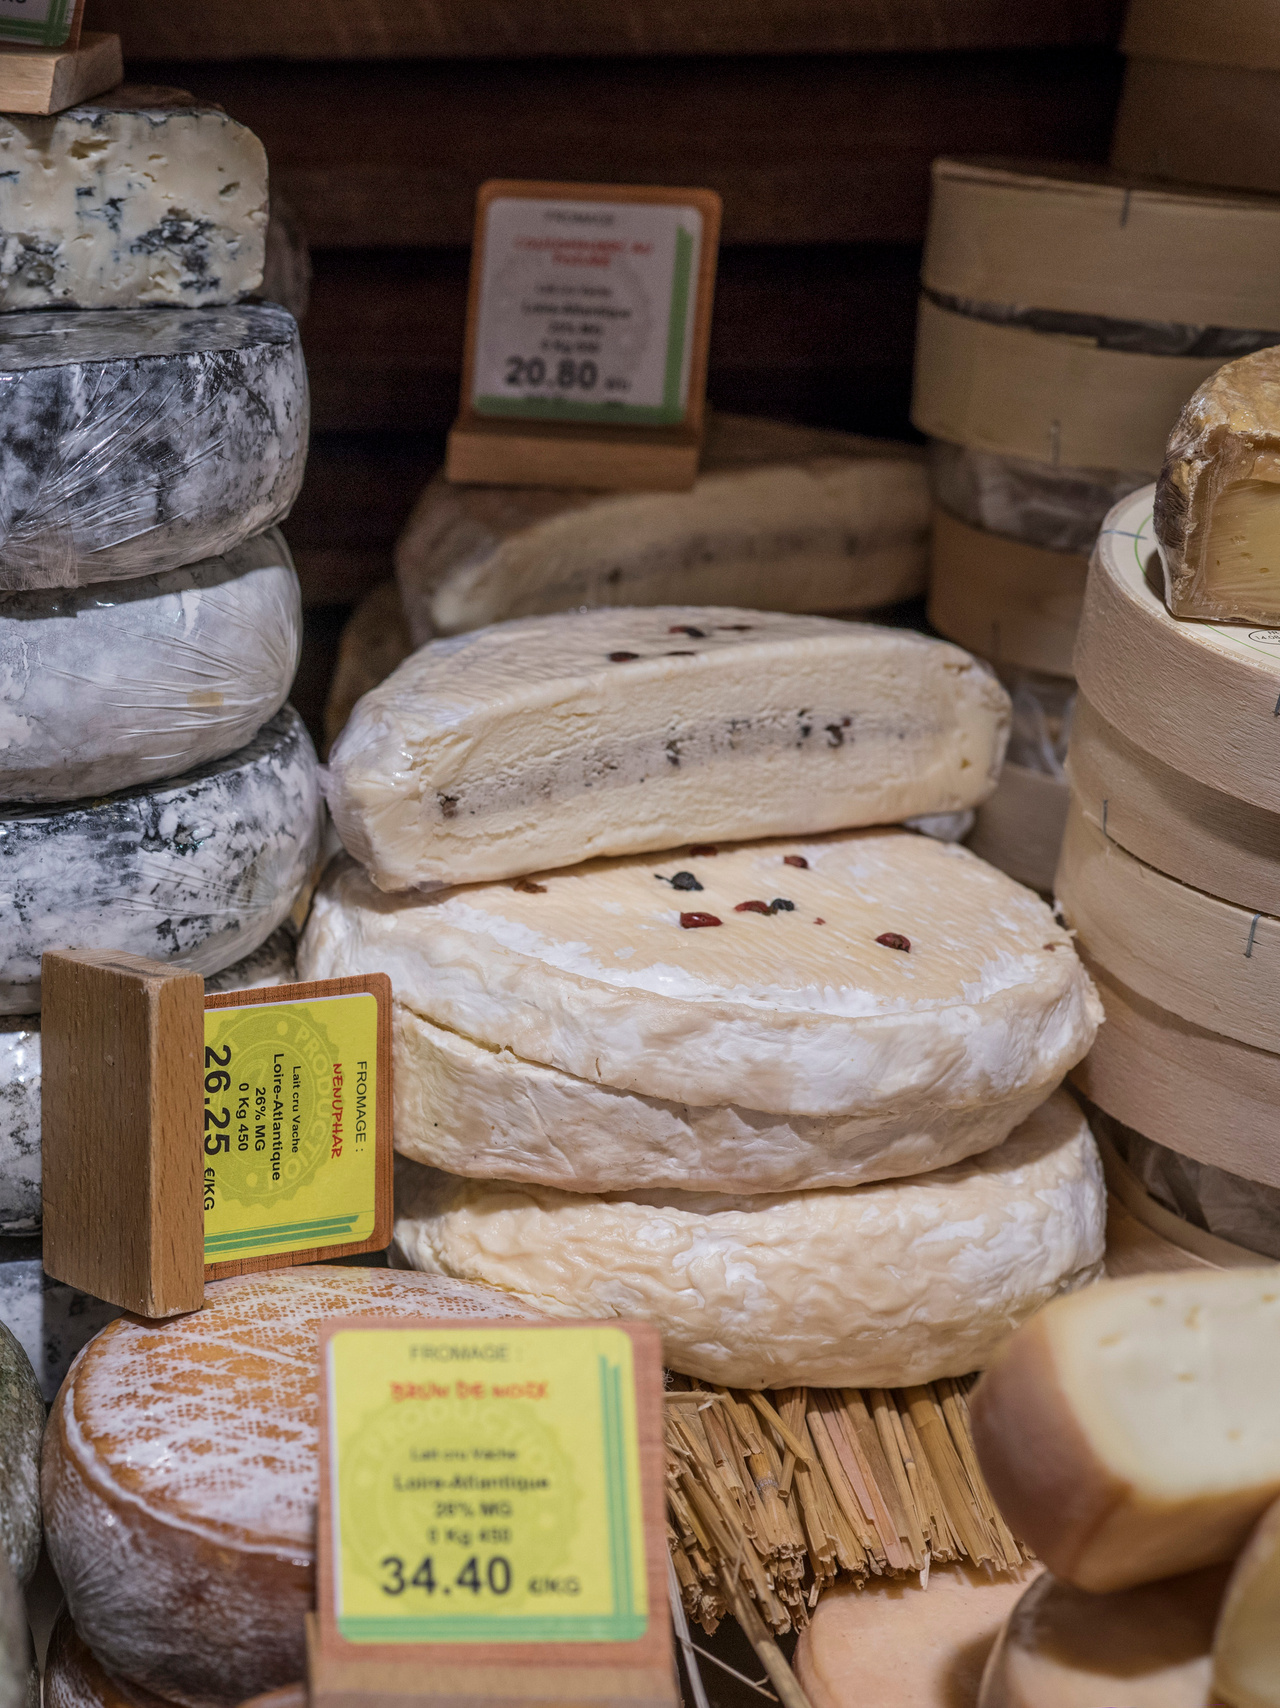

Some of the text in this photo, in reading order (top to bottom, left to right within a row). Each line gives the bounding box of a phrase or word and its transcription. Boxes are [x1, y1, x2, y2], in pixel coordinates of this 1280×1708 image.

[504, 354, 599, 390] 20.80
[204, 1043, 233, 1211] 26.25 €/KG
[235, 1096, 250, 1120] Kg
[254, 1086, 267, 1152] 26% MG
[271, 1052, 285, 1182] Loire-Atlantique
[291, 1065, 302, 1154] Lait cru Vache
[330, 1062, 344, 1160] NENUPHAR
[355, 1060, 368, 1144] FROMAGE
[237, 1123, 250, 1152] 450
[410, 1344, 510, 1362] FROMAGE
[380, 1555, 514, 1597] 34.40
